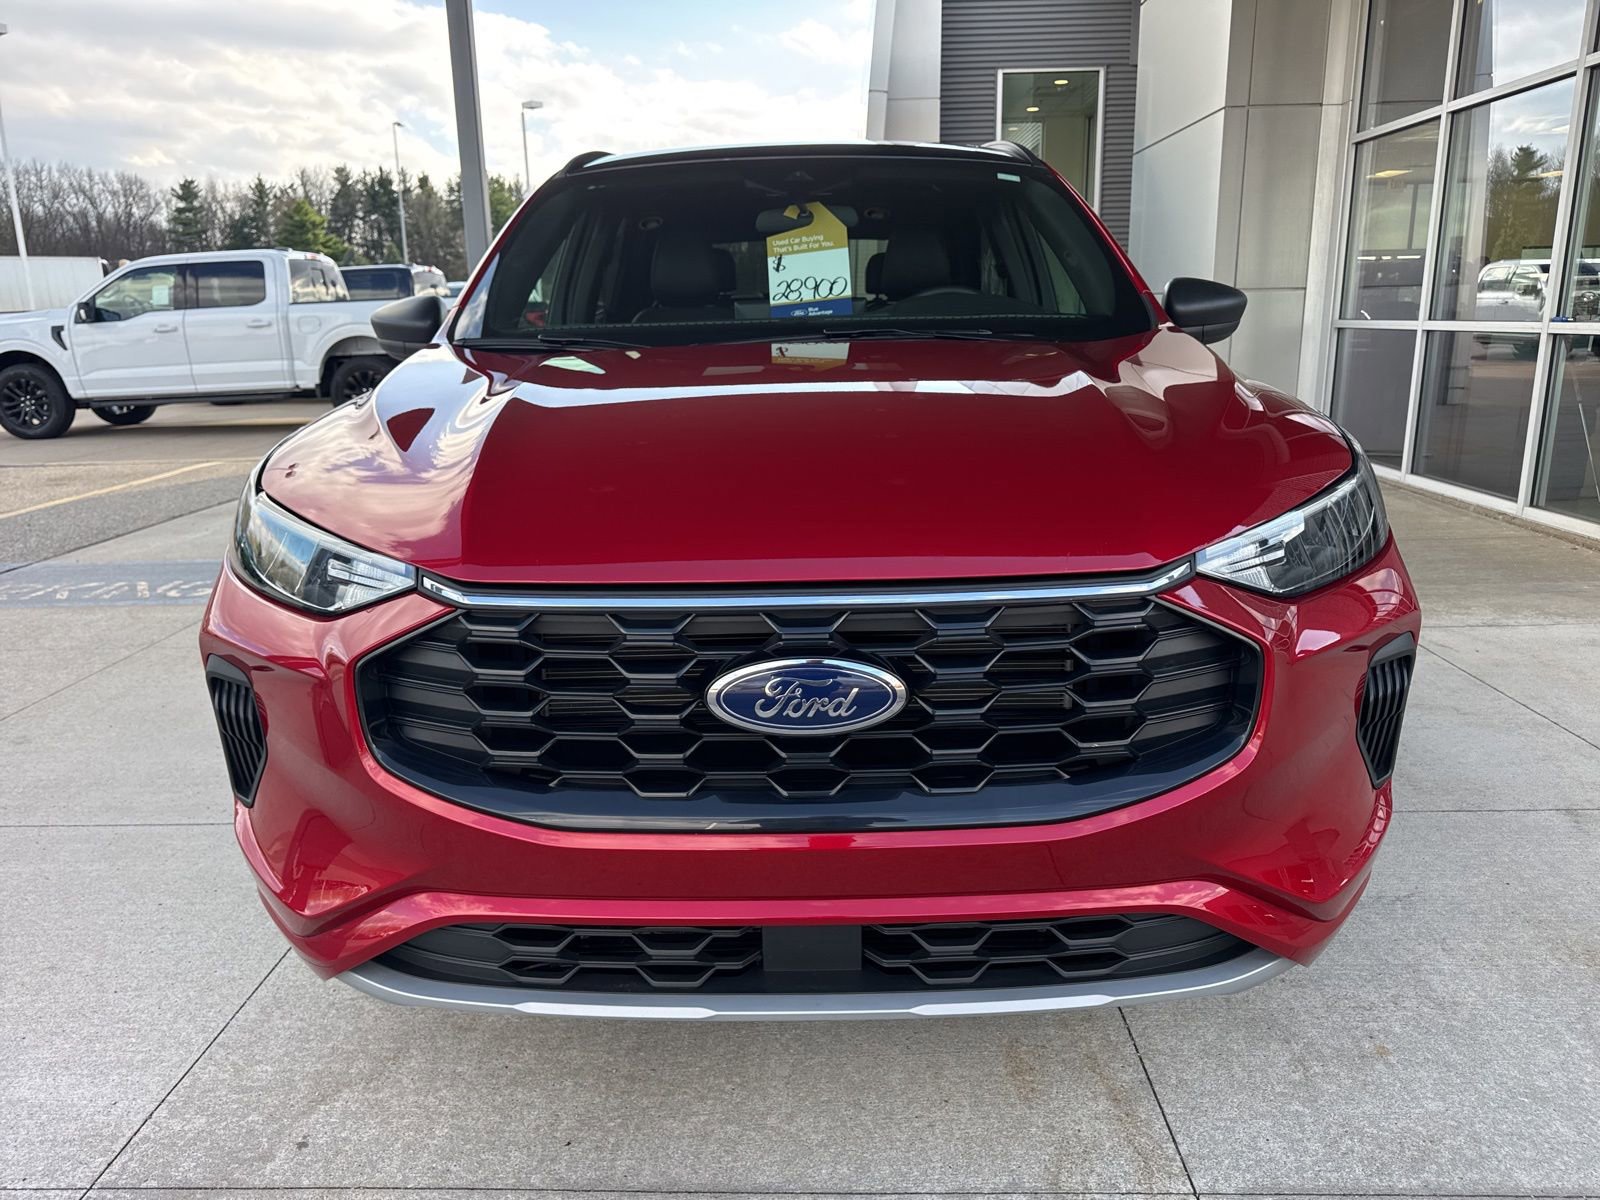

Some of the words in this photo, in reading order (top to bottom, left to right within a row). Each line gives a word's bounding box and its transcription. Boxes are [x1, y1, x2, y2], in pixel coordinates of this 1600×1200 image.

[772, 238, 789, 246] Used
[802, 234, 824, 242] Buying
[773, 245, 792, 253] That's
[772, 254, 786, 273] $
[772, 276, 848, 302] 28,900
[754, 676, 859, 718] Ford
